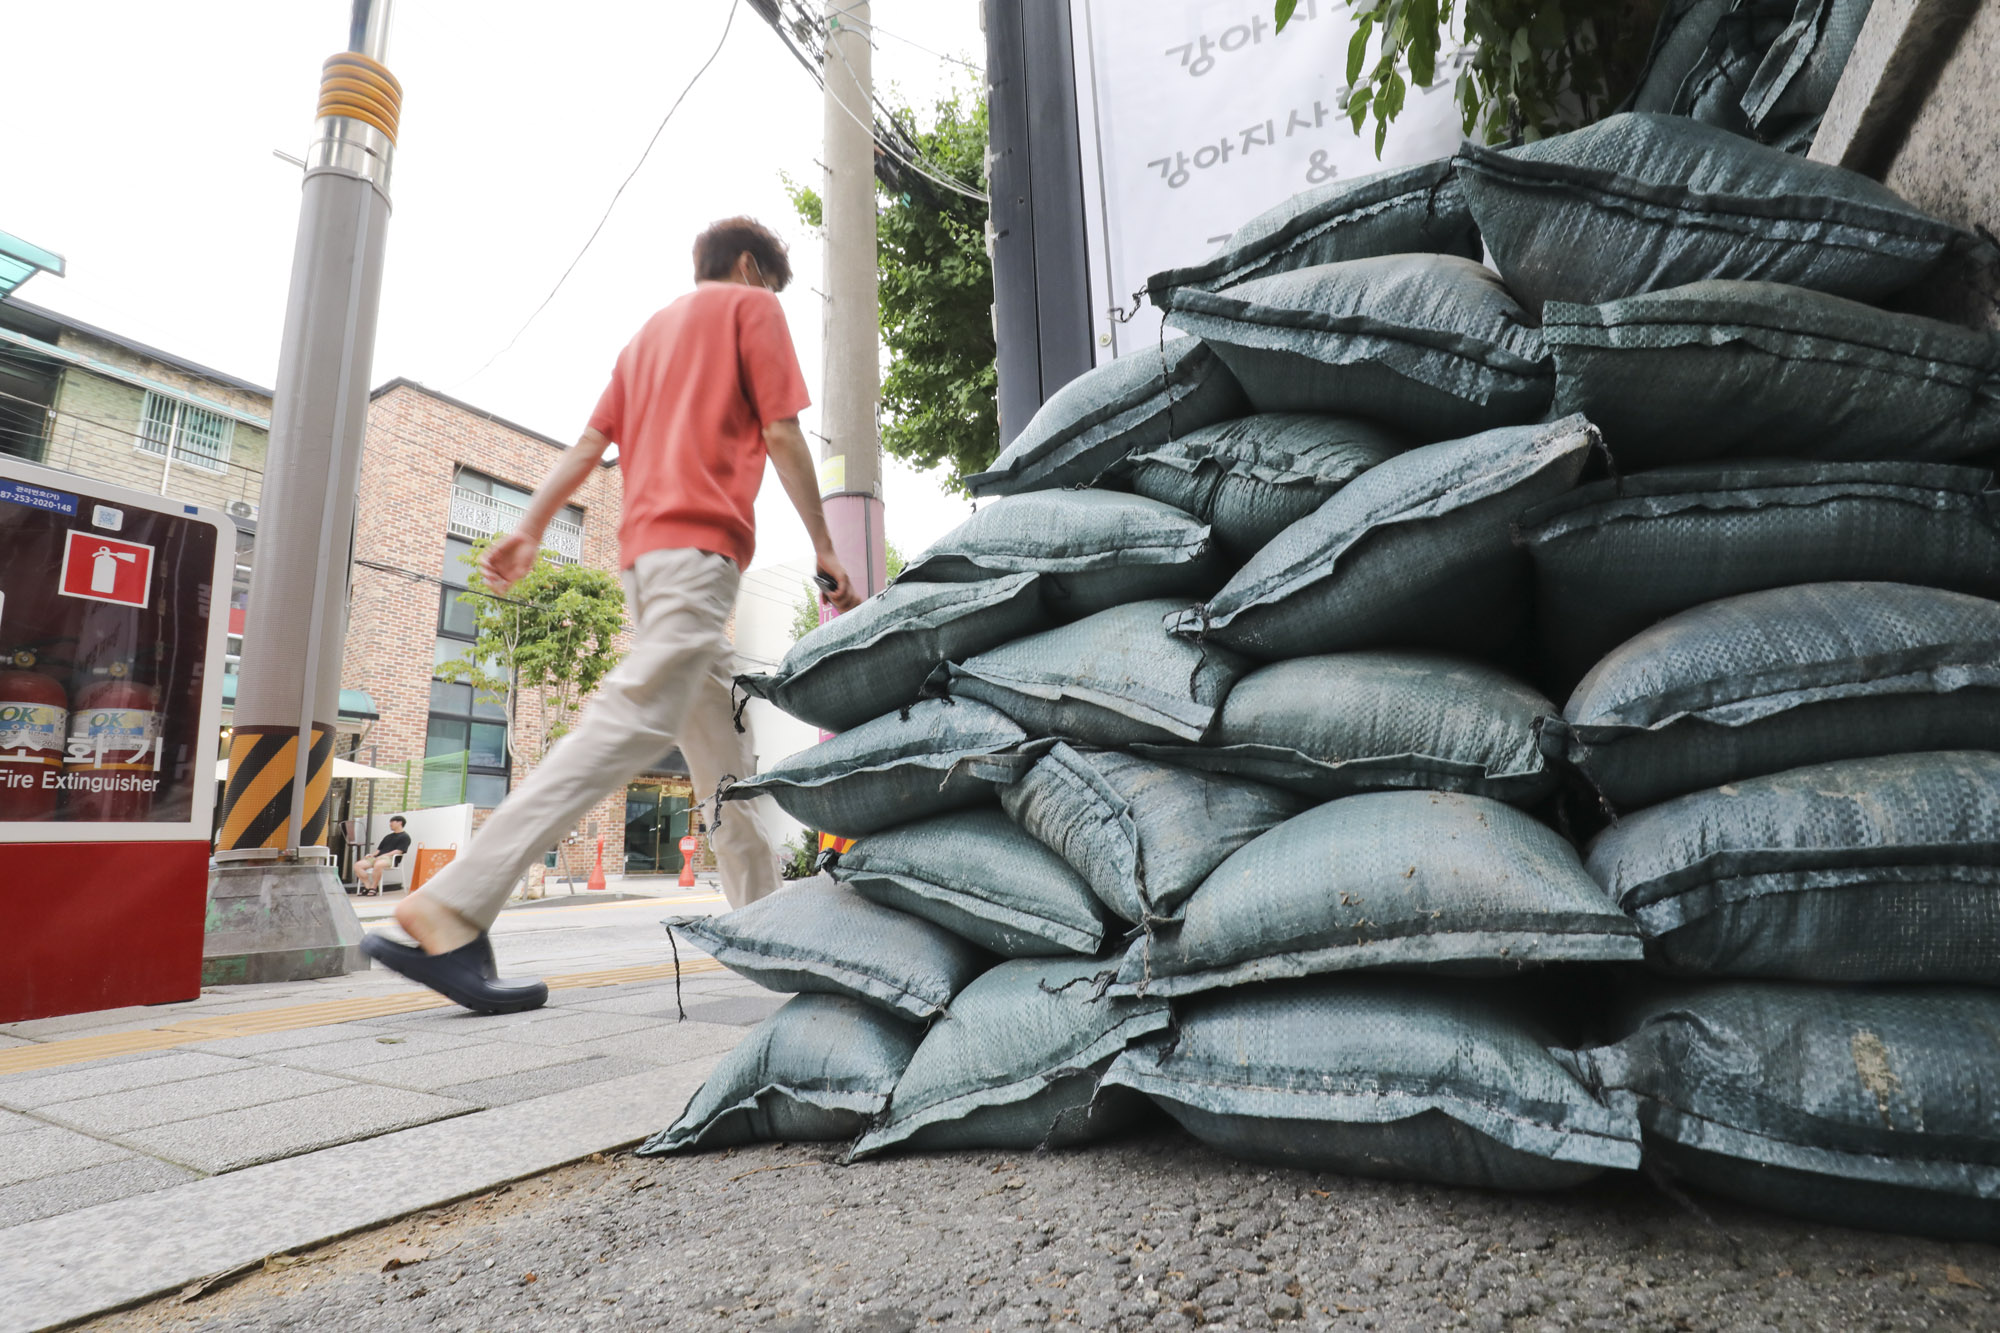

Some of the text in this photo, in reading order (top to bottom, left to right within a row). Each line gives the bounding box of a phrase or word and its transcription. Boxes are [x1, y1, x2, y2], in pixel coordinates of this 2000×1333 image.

[1305, 149, 1339, 184] &
[0, 706, 39, 723] OK
[90, 712, 126, 728] OK
[0, 729, 163, 772] 소화기
[42, 770, 160, 793] Extinguisher
